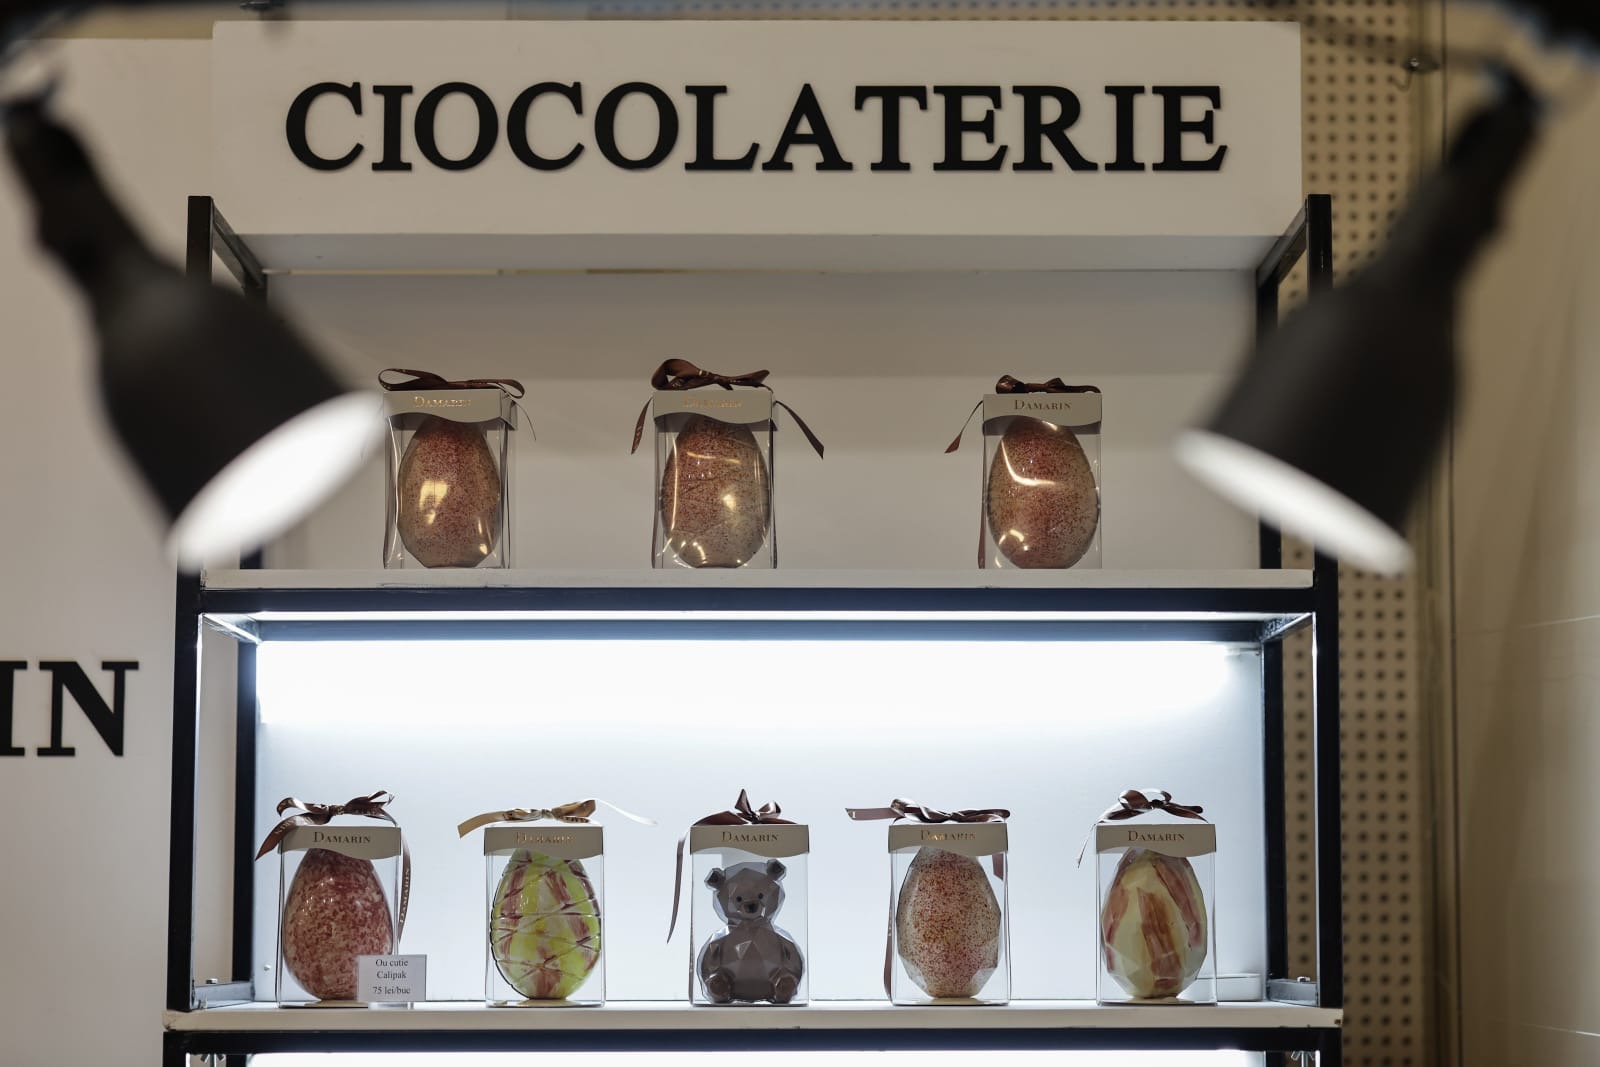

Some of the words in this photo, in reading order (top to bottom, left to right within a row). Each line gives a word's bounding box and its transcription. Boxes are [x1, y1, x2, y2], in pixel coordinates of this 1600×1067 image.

[286, 82, 1227, 171] CIOCOLATERIE
[1014, 399, 1072, 410] DAMARIN
[313, 831, 371, 844] DAMARIN
[721, 831, 779, 843] DAMARIN
[1128, 830, 1185, 842] DAMARIN
[375, 958, 388, 967] Ou
[389, 958, 409, 967] cutie
[376, 970, 407, 981] Calipak
[372, 986, 382, 994] 75
[384, 986, 411, 995] lei/buc
